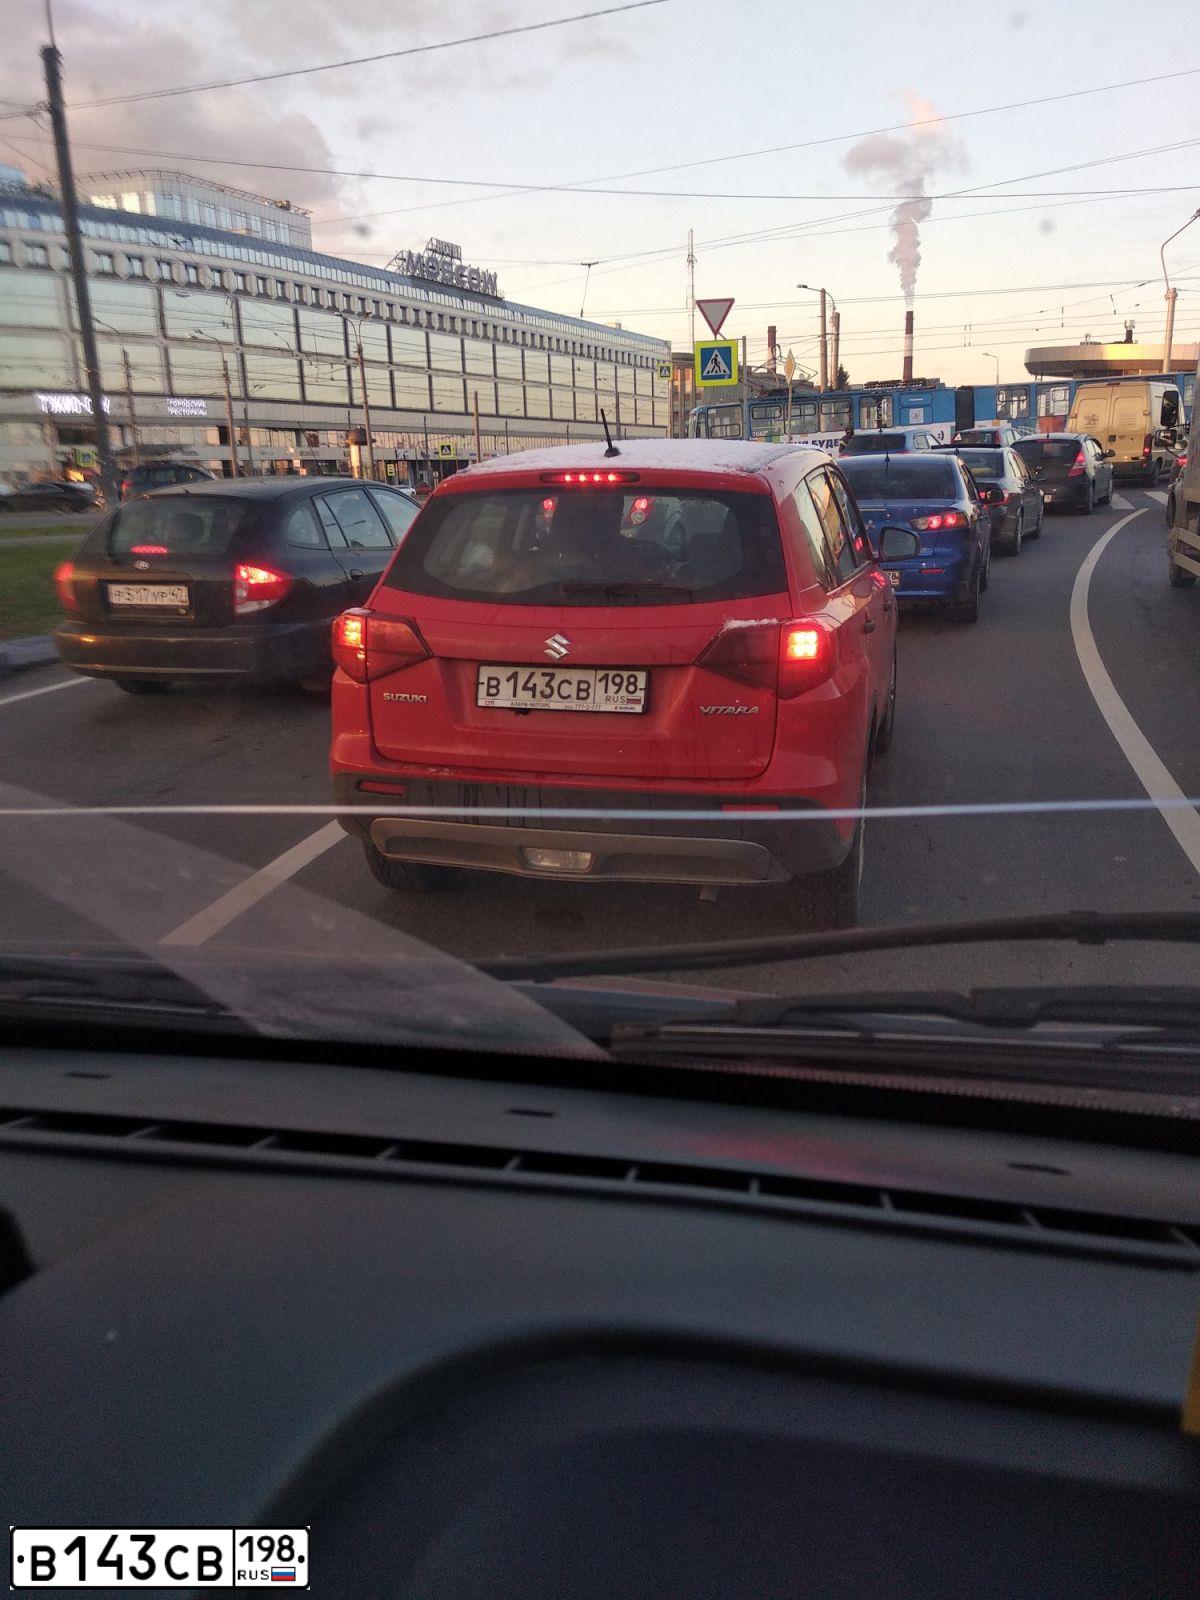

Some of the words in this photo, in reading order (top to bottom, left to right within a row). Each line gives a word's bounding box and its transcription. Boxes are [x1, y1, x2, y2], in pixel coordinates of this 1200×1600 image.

[406, 250, 497, 296] MOSCOW
[486, 671, 591, 701] В143СВ
[598, 673, 638, 695] 198
[383, 692, 427, 703] SUZUKI
[605, 696, 626, 704] RUS
[699, 705, 759, 715] VITARA
